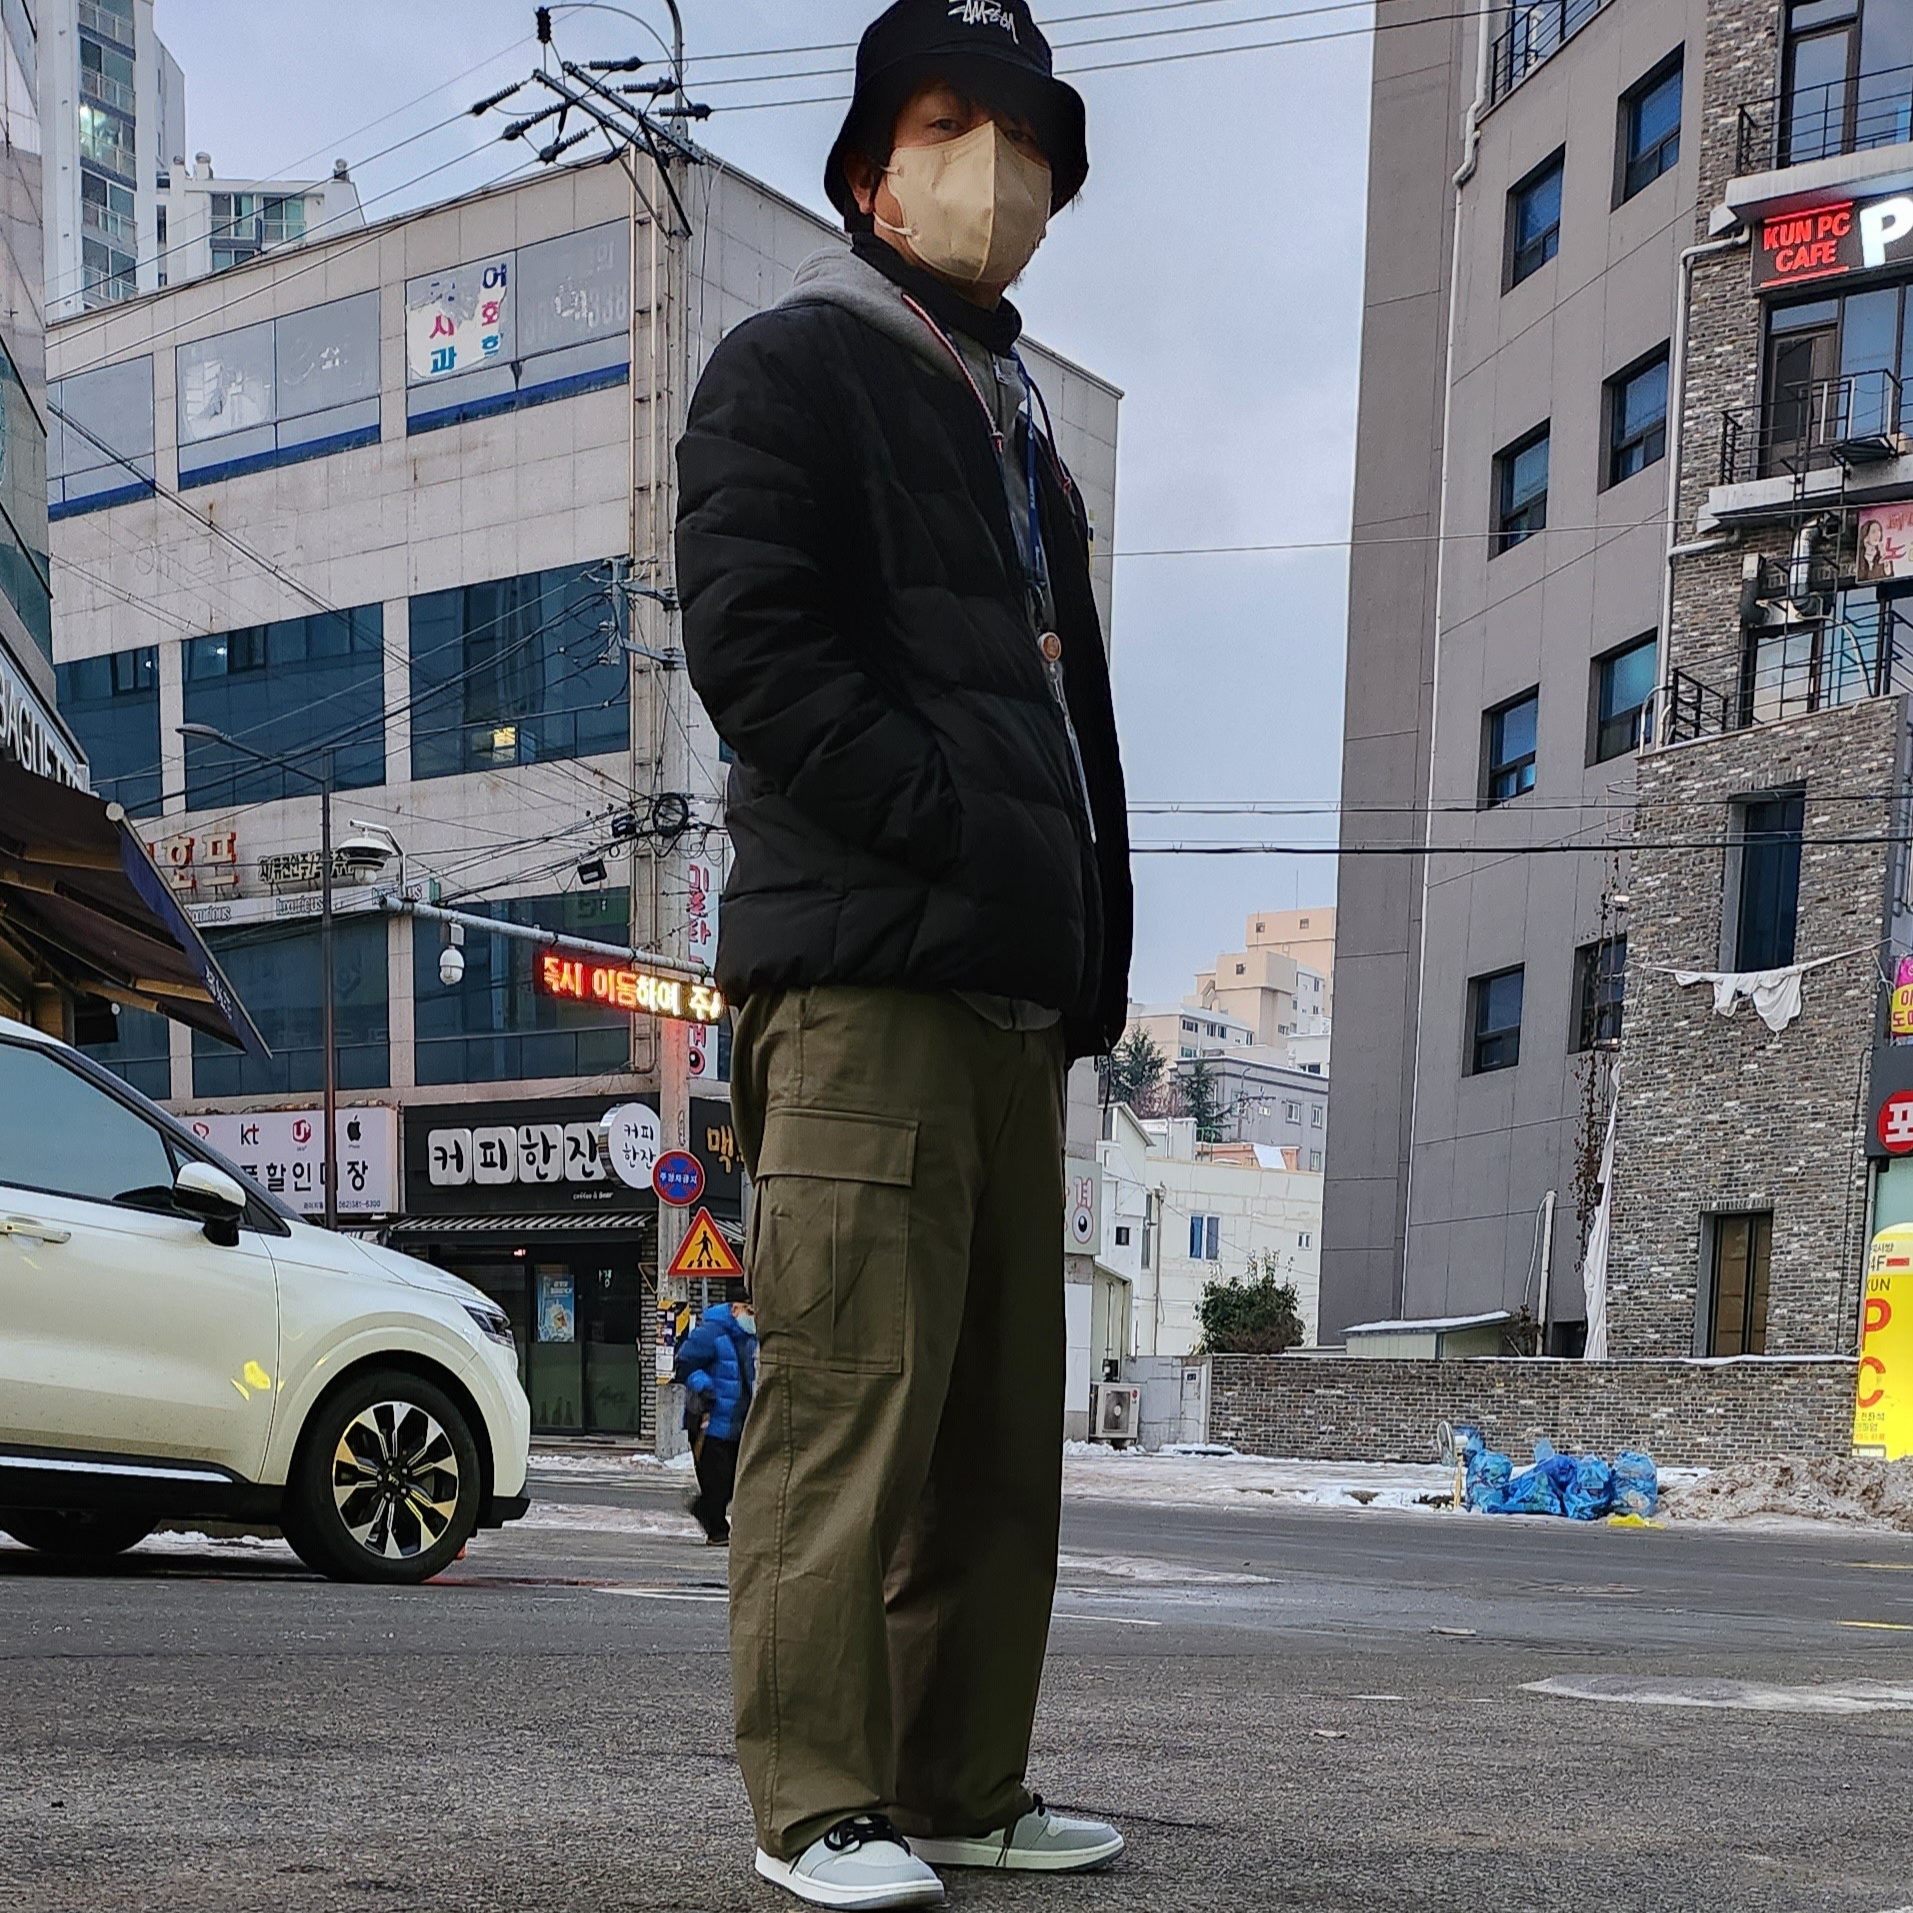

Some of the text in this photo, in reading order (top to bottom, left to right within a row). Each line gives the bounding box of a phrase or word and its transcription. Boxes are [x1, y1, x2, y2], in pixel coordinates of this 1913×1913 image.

[1764, 212, 1850, 250] KUN PC
[1776, 240, 1837, 273] CAFE
[430, 345, 457, 374] 과
[593, 967, 682, 1016] 이동하여
[240, 1123, 260, 1146] kt
[624, 1123, 654, 1140] 커피
[433, 1127, 602, 1180] 커피한잔
[622, 1142, 656, 1170] 한잔
[707, 1125, 743, 1173] 맥
[240, 1160, 368, 1192] 할인장
